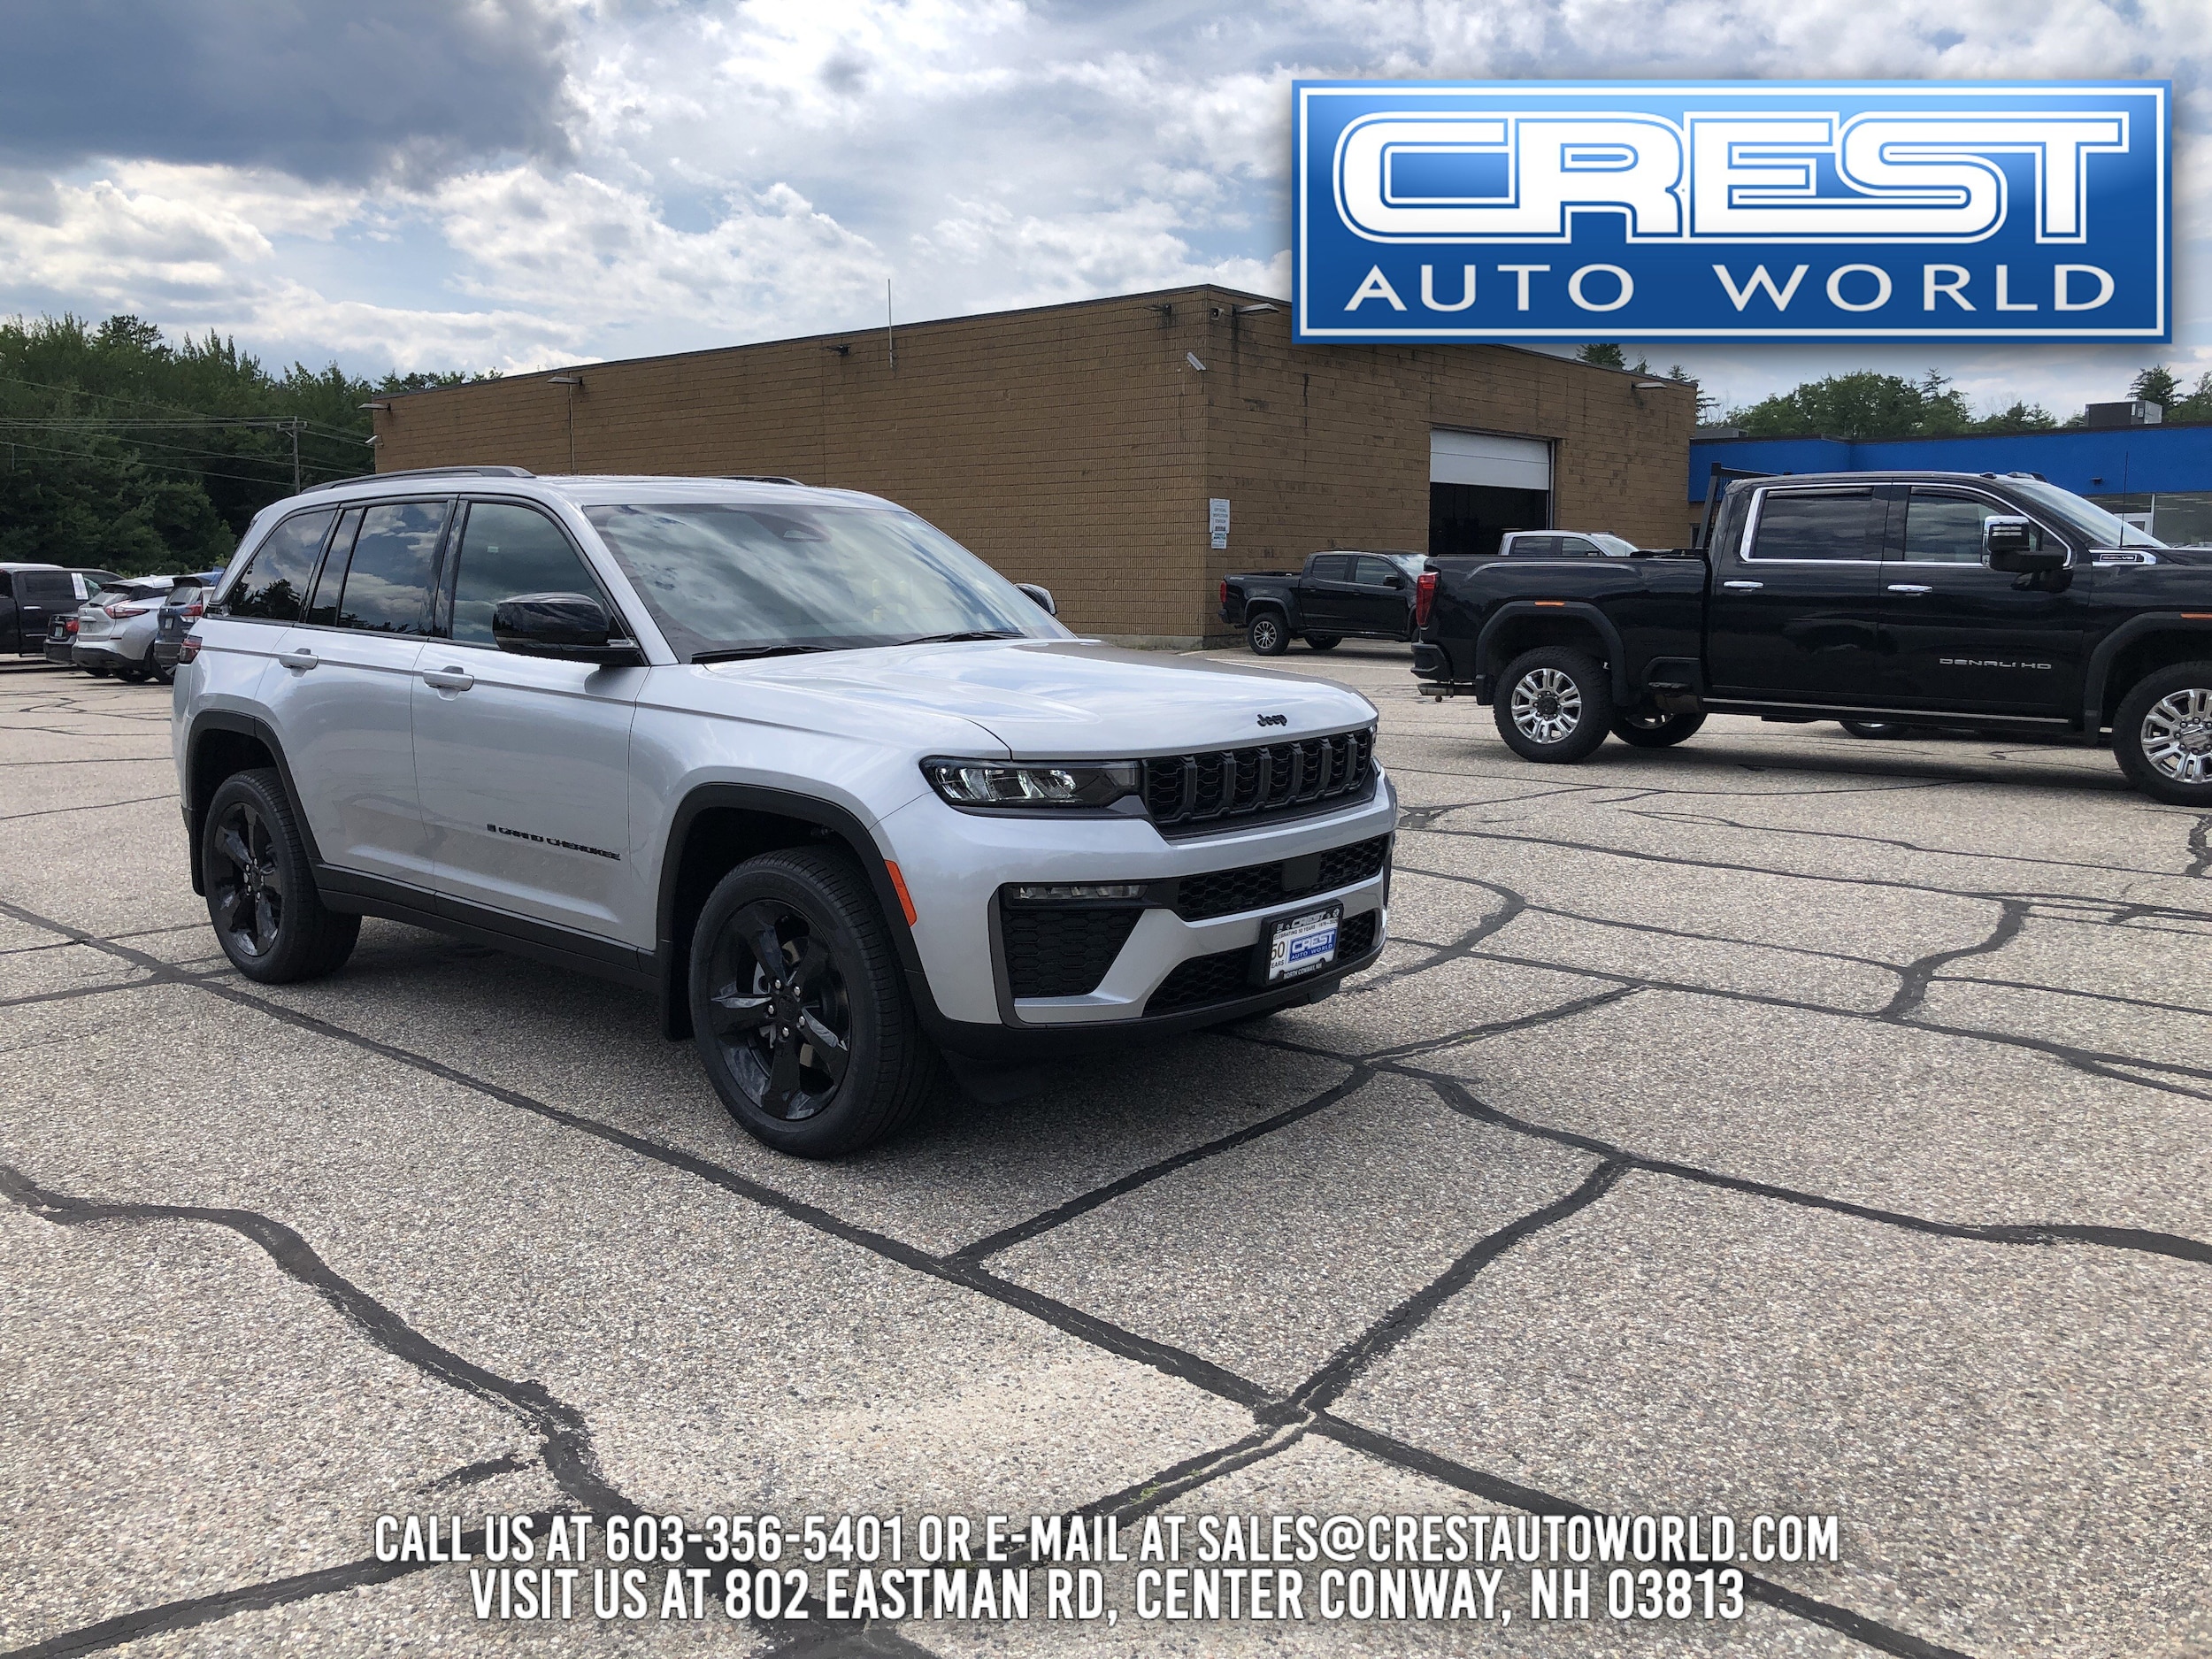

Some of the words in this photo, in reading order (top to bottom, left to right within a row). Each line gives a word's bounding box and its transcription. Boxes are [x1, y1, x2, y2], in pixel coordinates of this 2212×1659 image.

[1939, 657, 2016, 668] DENALI
[1256, 713, 1287, 726] Jeep
[498, 826, 544, 842] GRAND
[546, 837, 621, 861] CHEROKEE
[1291, 910, 1327, 929] CREST
[1292, 930, 1335, 954] CREST
[1291, 951, 1309, 961] AUTO
[1311, 943, 1333, 955] WORLD
[1271, 960, 1285, 969] EARS
